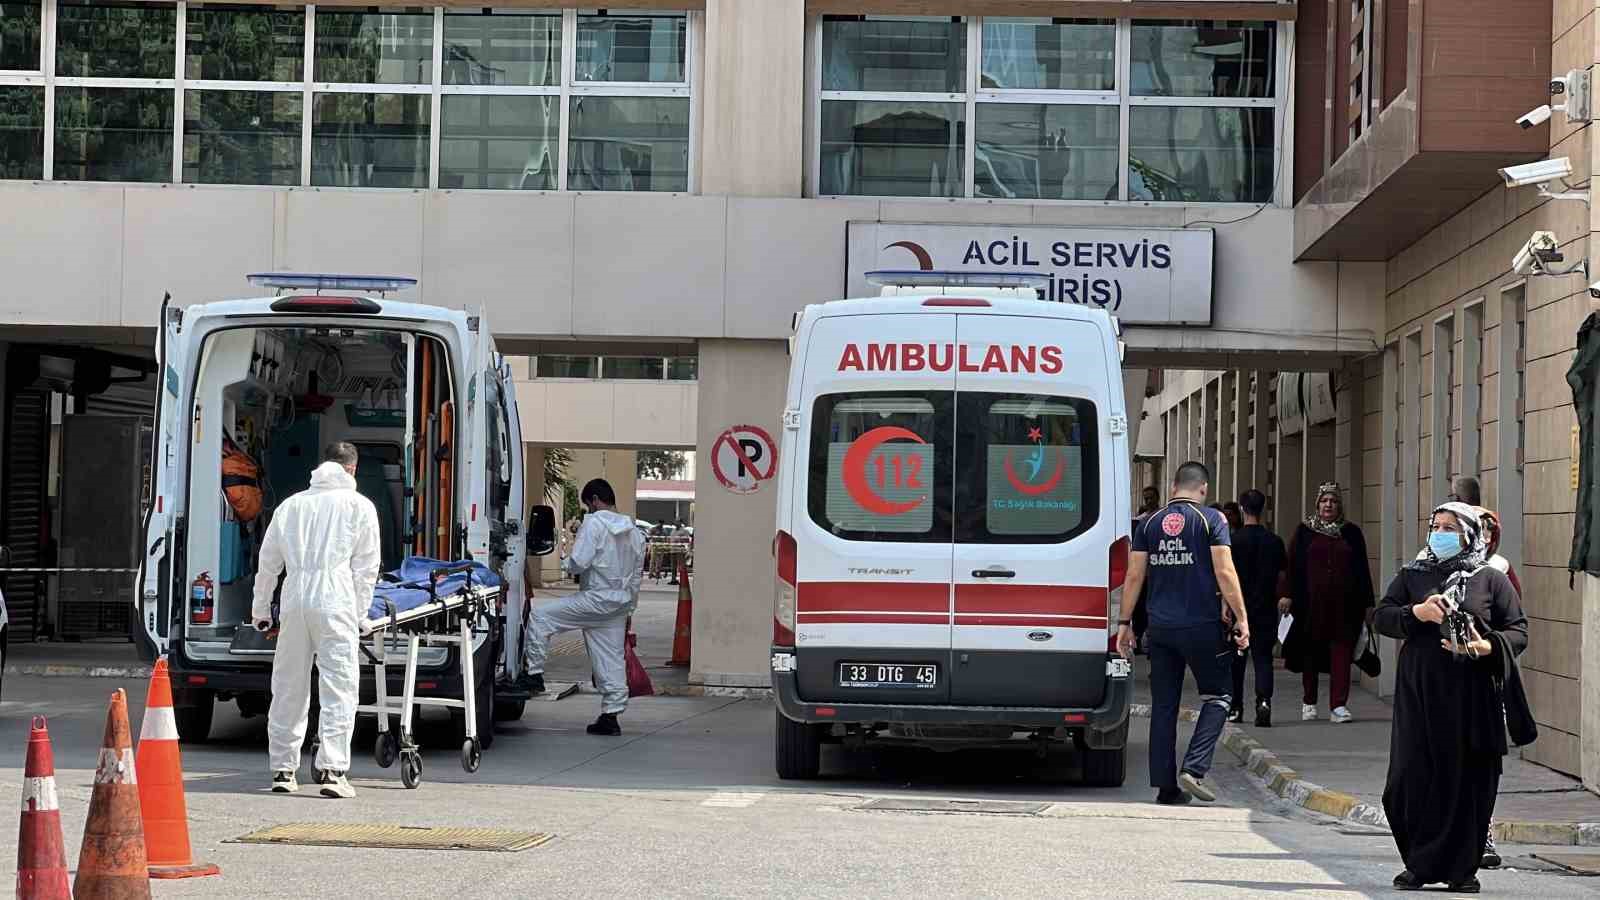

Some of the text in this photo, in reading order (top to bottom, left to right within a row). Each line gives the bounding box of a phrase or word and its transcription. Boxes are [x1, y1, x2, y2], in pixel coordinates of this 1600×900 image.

[962, 235, 1172, 270] ACİL SERVİS
[837, 343, 1064, 374] AMBULANS
[873, 453, 924, 489] 112
[1158, 537, 1186, 551] ACİL
[1149, 550, 1194, 565] SAĞLIK
[850, 666, 933, 682] 33 DTG 45
